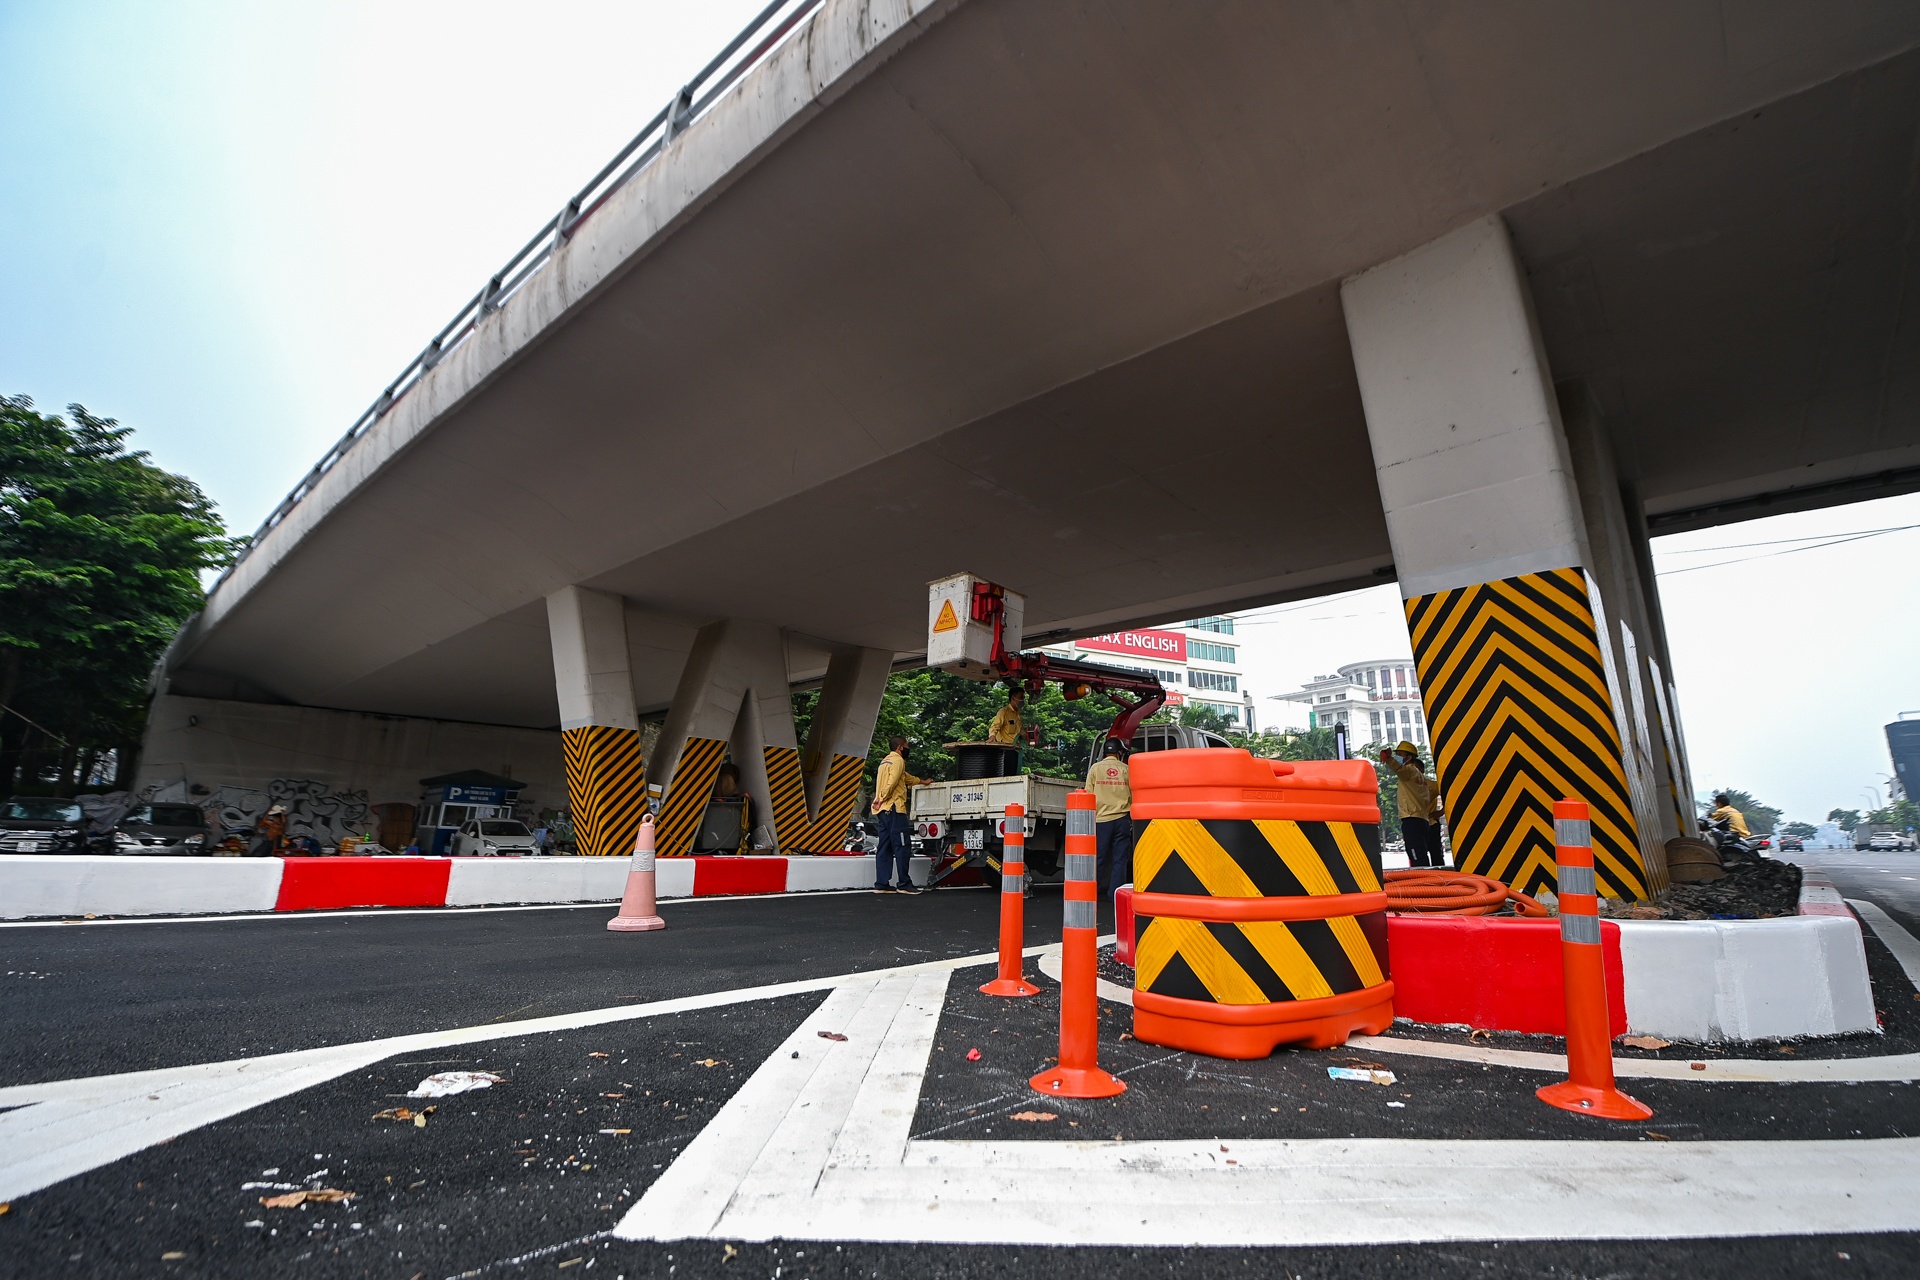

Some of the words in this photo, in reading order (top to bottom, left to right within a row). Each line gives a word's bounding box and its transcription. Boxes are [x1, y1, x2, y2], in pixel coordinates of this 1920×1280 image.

[1124, 633, 1179, 653] ENGLISH
[449, 787, 462, 800] P
[952, 793, 963, 803] 29C
[967, 791, 984, 802] 31345
[967, 830, 979, 840] 29C
